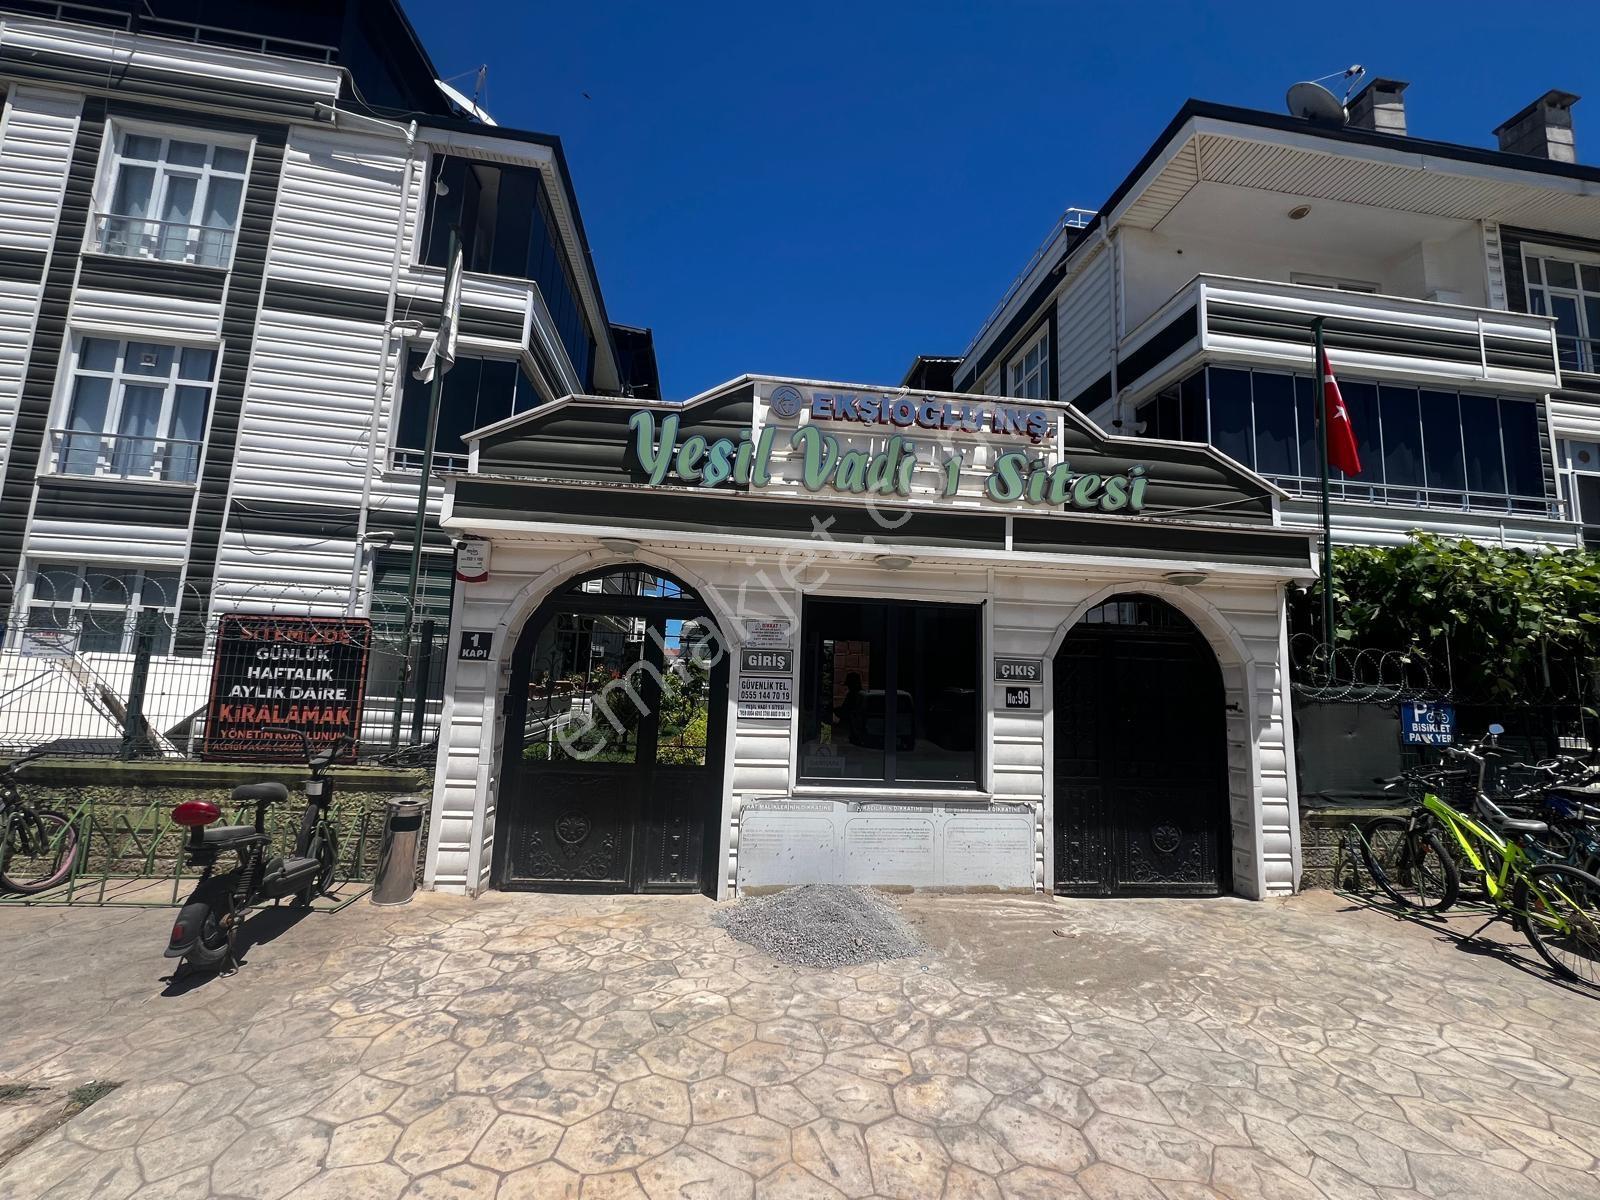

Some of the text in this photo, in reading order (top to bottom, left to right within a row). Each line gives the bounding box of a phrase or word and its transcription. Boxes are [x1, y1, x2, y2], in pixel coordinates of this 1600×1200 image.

[811, 392, 986, 432] EKŞİOĞLU
[629, 409, 775, 488] Yeşil
[791, 424, 917, 497] Vadi
[984, 451, 1150, 512] Sitesi
[256, 645, 330, 662] GÜNLÜK
[461, 648, 487, 658] KAPI
[748, 653, 785, 669] GİRİŞ
[247, 666, 334, 682] HAFTALIK
[1001, 664, 1035, 679] ÇIKIŞ
[741, 680, 789, 691] GÜVENLİK TEL.
[740, 690, 790, 700] 0555 144 70 19
[1007, 690, 1029, 705] No:96
[1409, 733, 1434, 743] PAK
